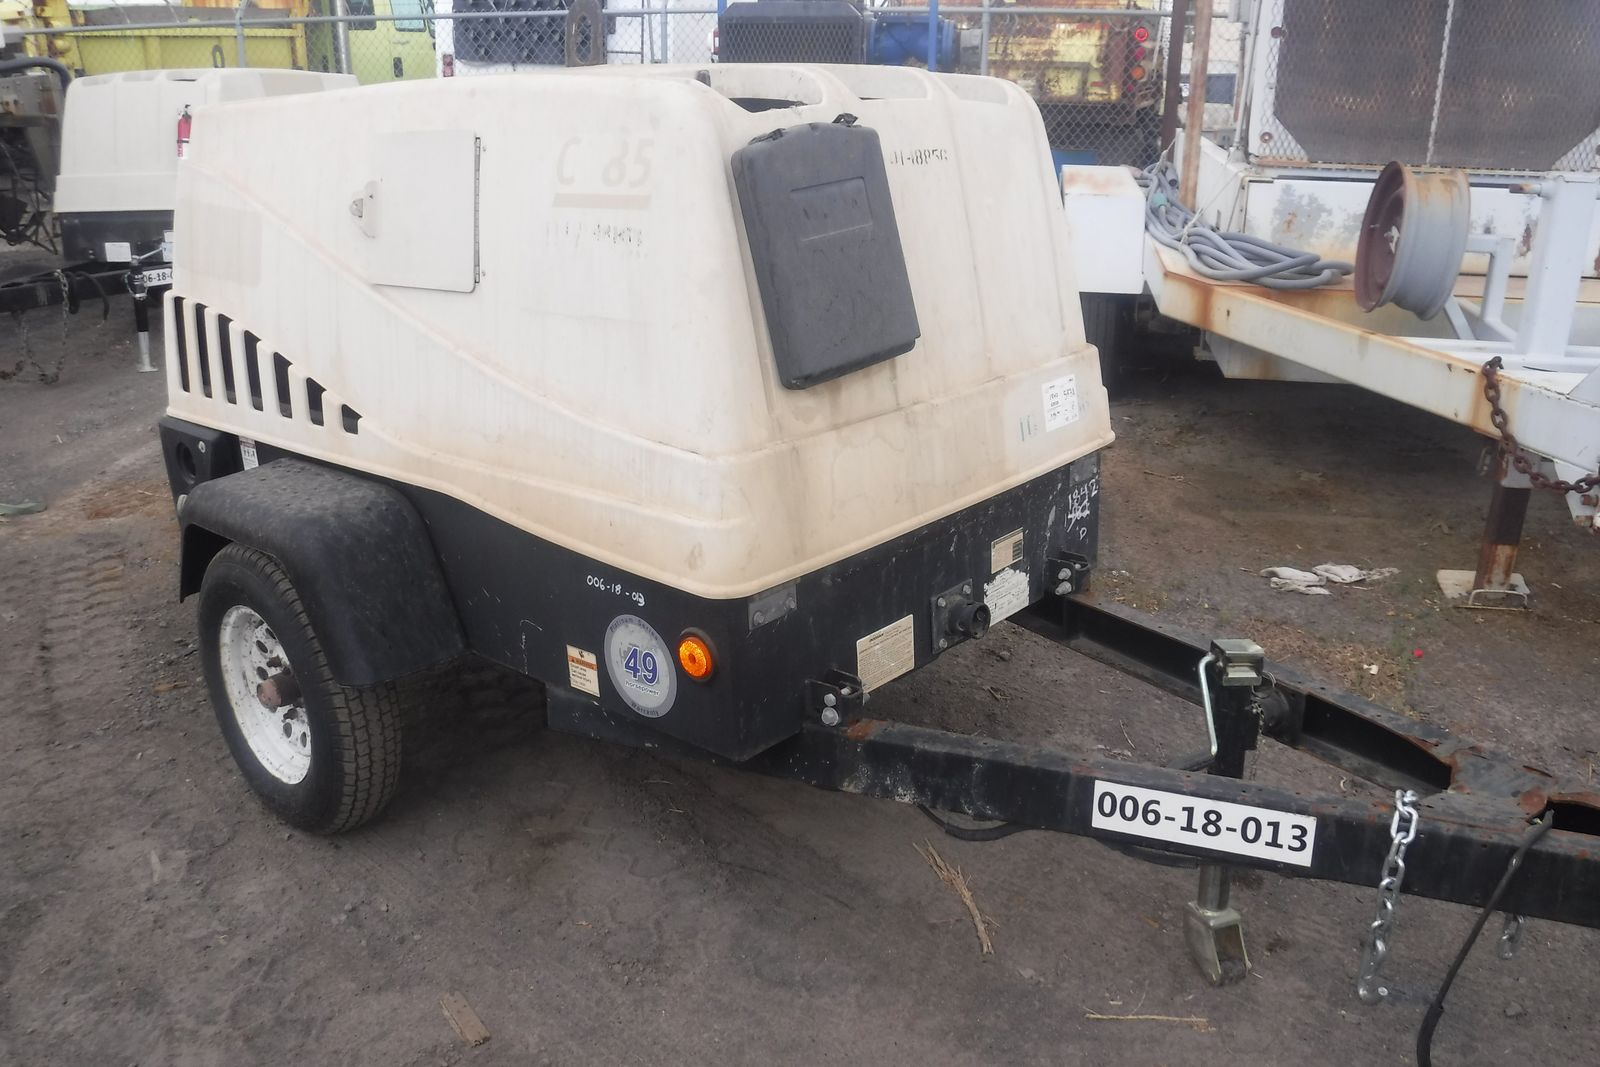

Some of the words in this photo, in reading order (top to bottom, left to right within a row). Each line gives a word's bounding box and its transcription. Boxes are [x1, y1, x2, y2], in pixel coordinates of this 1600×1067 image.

[623, 646, 659, 686] 49
[625, 680, 660, 696] horsepower
[1097, 791, 1308, 852] 006-18-013
